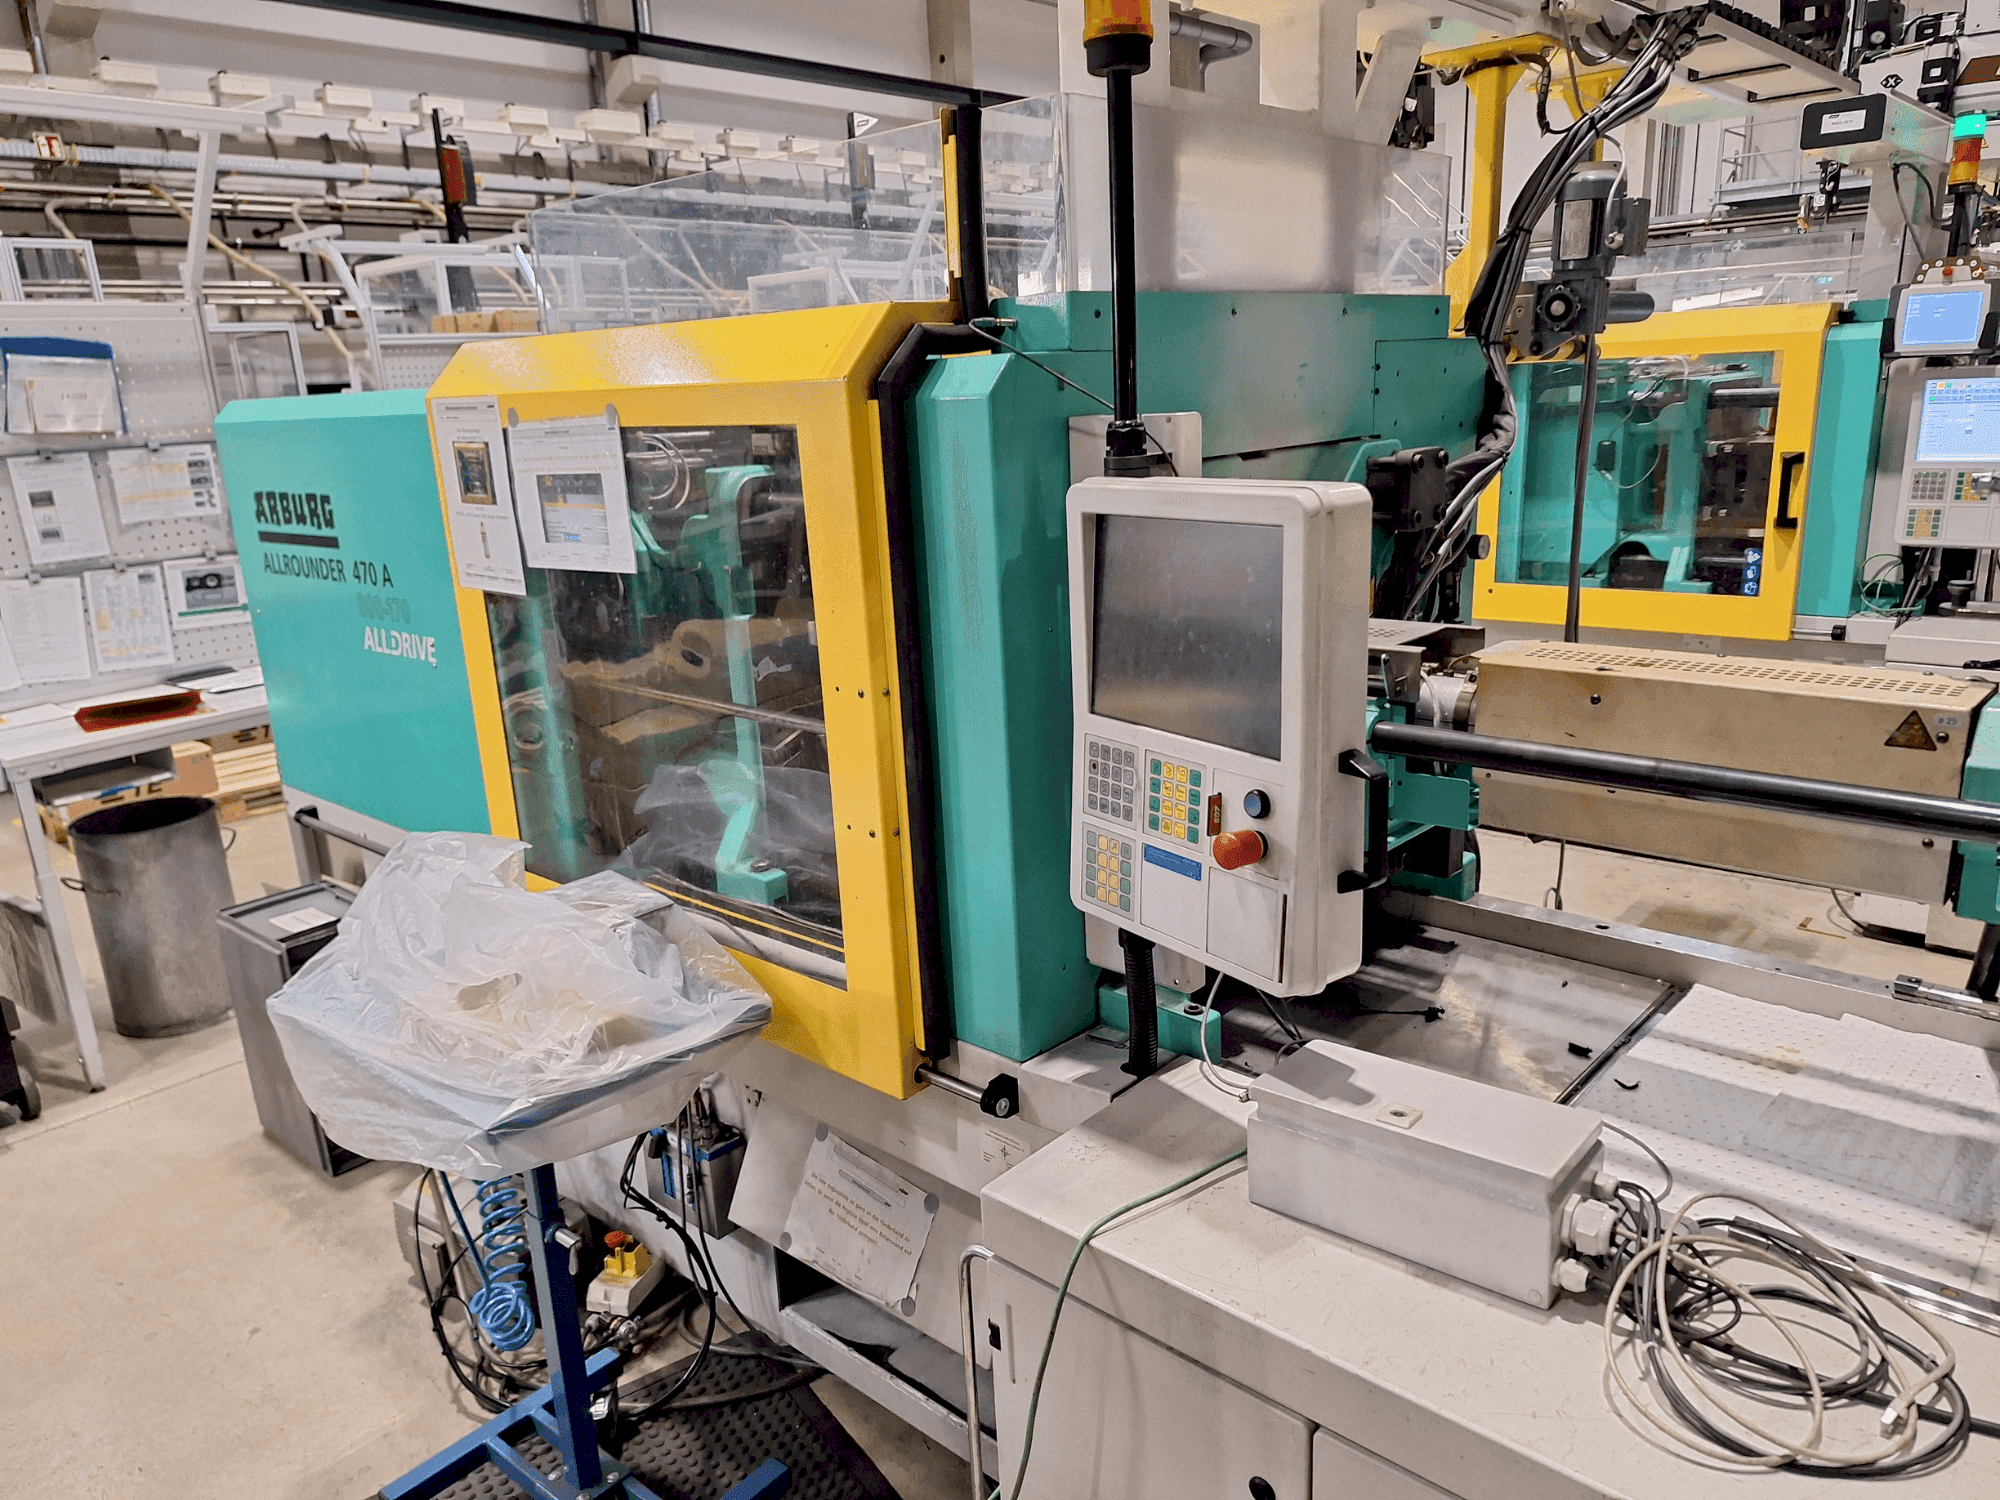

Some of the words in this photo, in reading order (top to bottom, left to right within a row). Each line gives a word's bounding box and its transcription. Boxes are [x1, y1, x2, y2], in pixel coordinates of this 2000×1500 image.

[254, 490, 336, 530] ARBURG
[263, 552, 347, 583] ALLROUNDER
[353, 560, 377, 586] 470
[382, 563, 394, 589] A
[364, 625, 437, 664] ALLDRIVE
